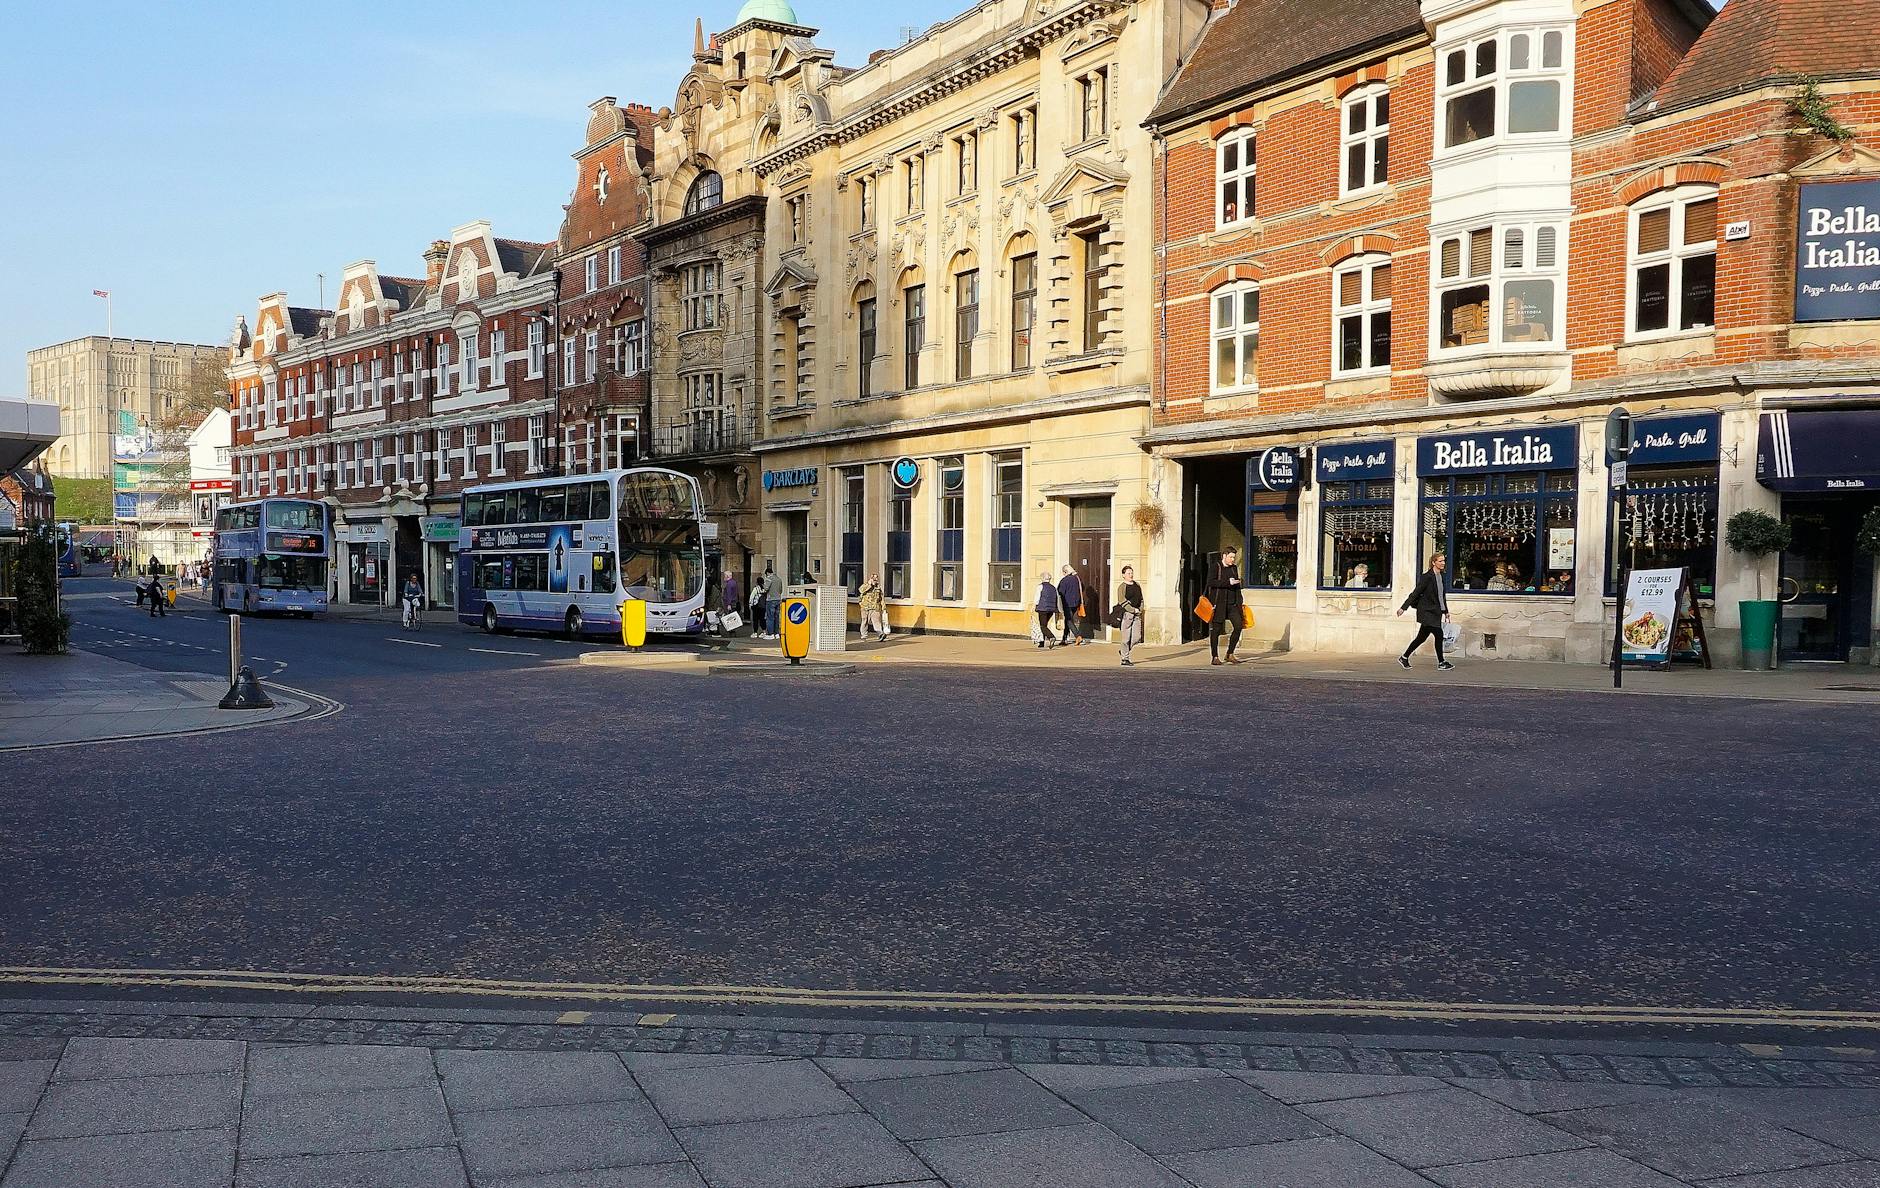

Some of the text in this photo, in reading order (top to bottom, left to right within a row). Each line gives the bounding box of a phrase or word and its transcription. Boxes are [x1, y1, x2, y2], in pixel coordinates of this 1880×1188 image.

[1806, 206, 1880, 236] Bella
[1803, 240, 1880, 268] Italia
[1802, 280, 1880, 297] Pizza Pasta Grill
[1645, 432, 1674, 448] Pasta
[1679, 428, 1707, 448] Grill
[1271, 452, 1293, 464] Bella
[1433, 435, 1553, 469] Bella Italia
[1322, 451, 1386, 473] Pizza Pasta Grill
[1270, 464, 1293, 476] Italia
[773, 468, 816, 487] BARCLAYS
[1827, 479, 1865, 488] Bella Italia
[308, 539, 316, 548] 15
[1337, 544, 1377, 552] TRATTORIA
[1470, 543, 1519, 551] TRATTORIA
[1637, 576, 1642, 584] 2
[1641, 588, 1664, 596] £12.99
